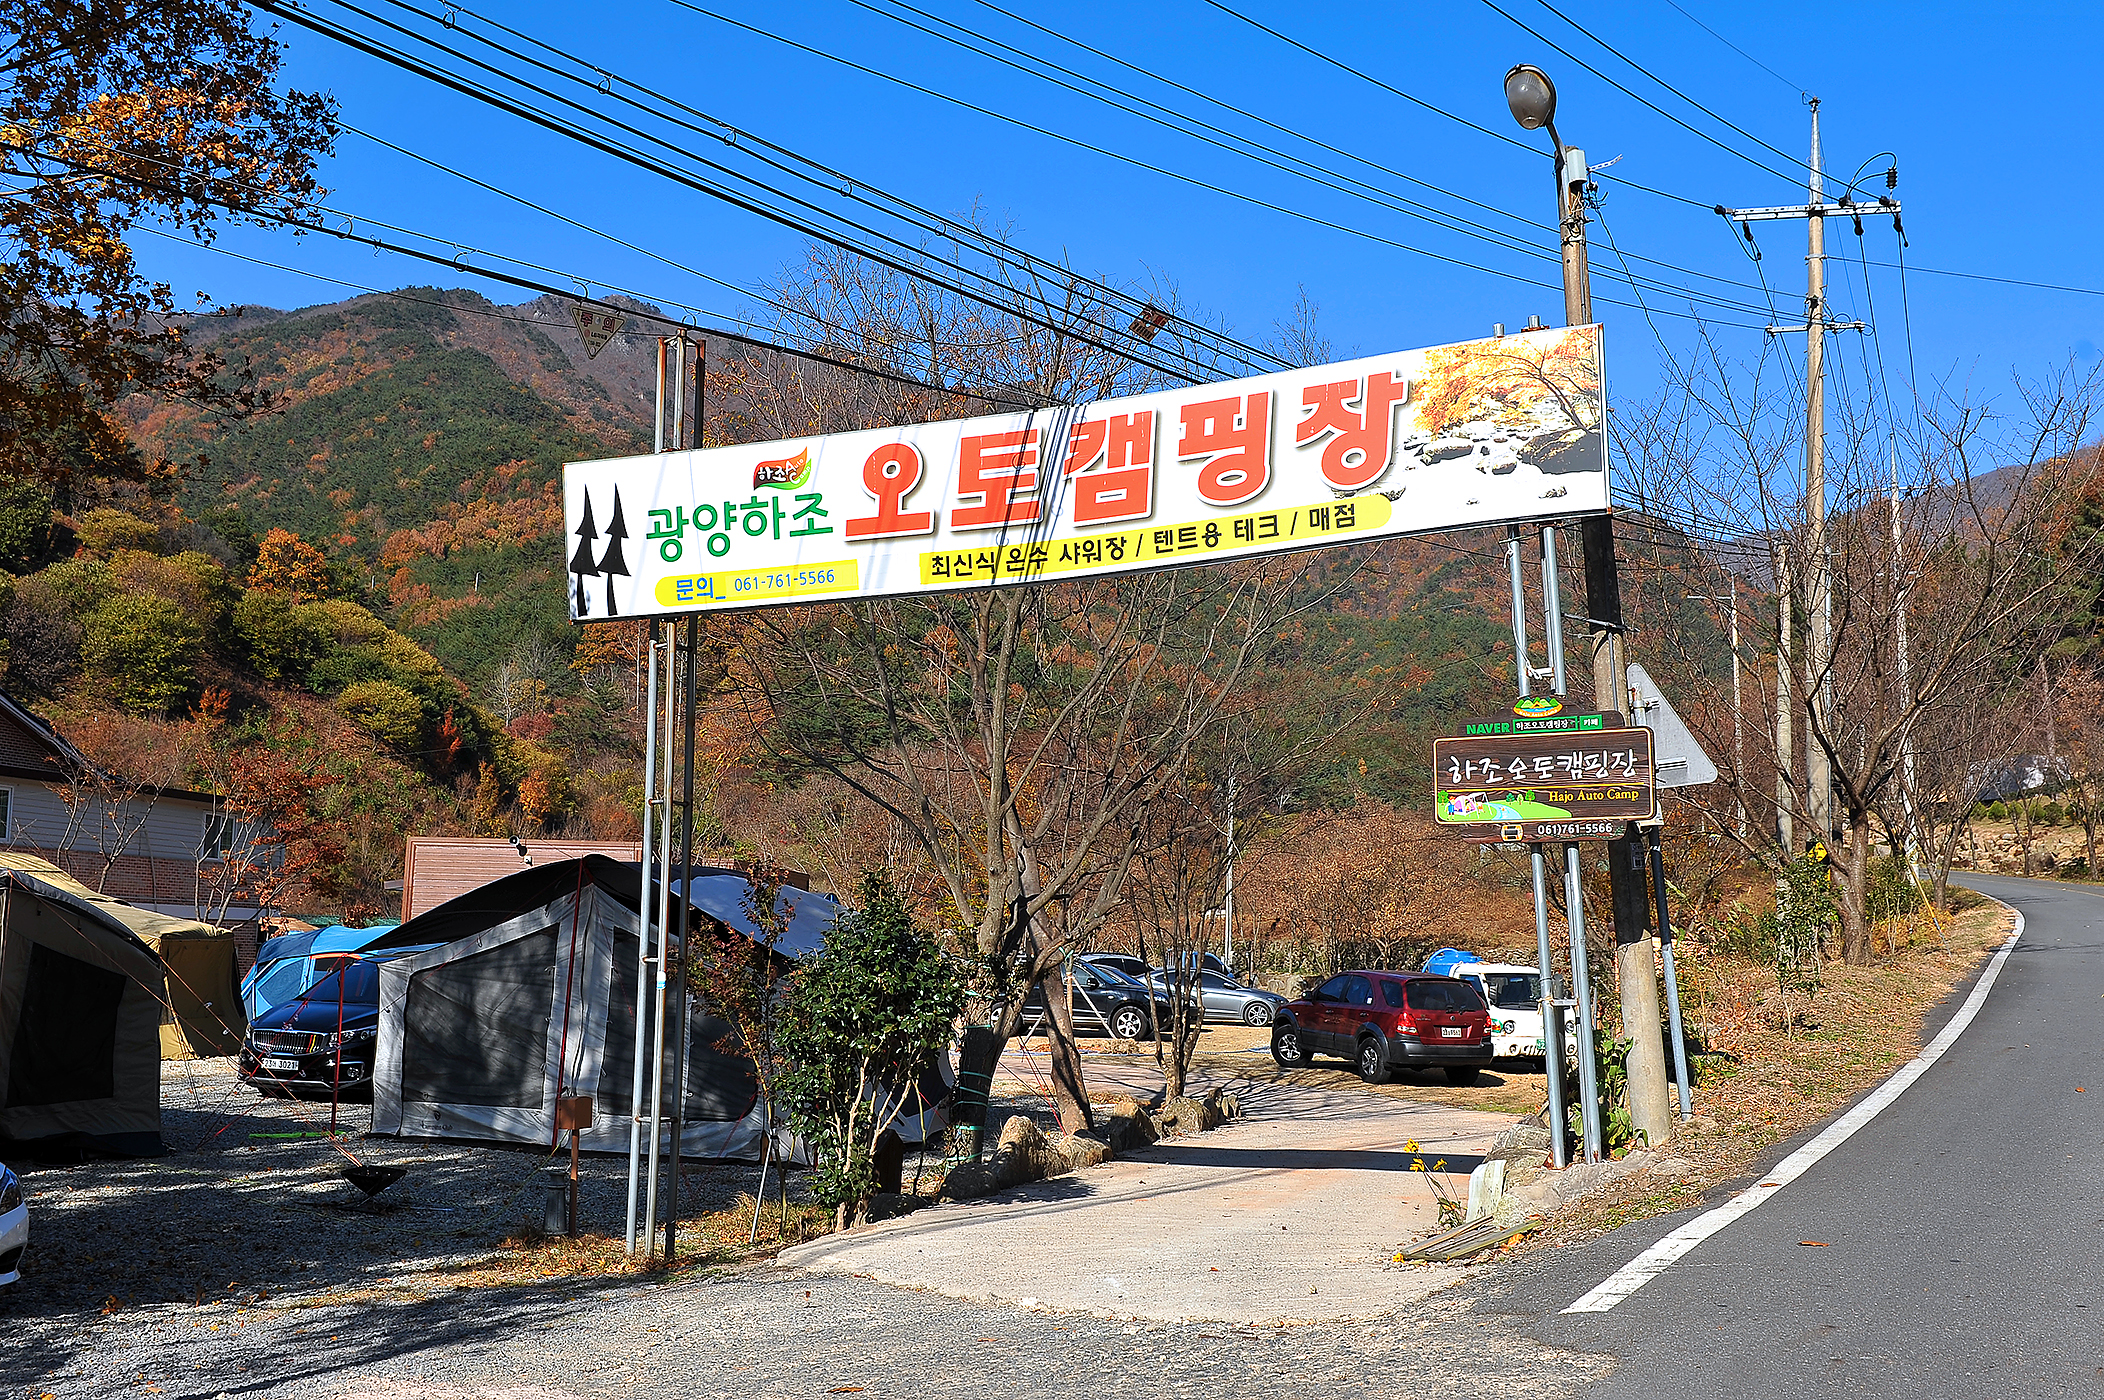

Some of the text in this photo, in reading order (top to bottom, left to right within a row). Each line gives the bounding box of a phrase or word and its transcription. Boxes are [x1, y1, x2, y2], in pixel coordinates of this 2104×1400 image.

[844, 370, 1407, 538] 오토캠핑장
[758, 465, 787, 482] 하조
[646, 493, 834, 563] 광양하조
[931, 551, 996, 577] 최신식
[1006, 546, 1049, 572] 온수
[1059, 536, 1127, 565] 샤워장
[1154, 521, 1222, 553] 텐트용
[1234, 514, 1279, 542] 테크
[1309, 503, 1355, 531] 매점
[735, 569, 835, 592] 061-761-5566
[1466, 722, 1511, 735] NAVER
[1549, 788, 1639, 804] Hajo Auto Camp
[1537, 822, 1613, 835] 061)761-5566
